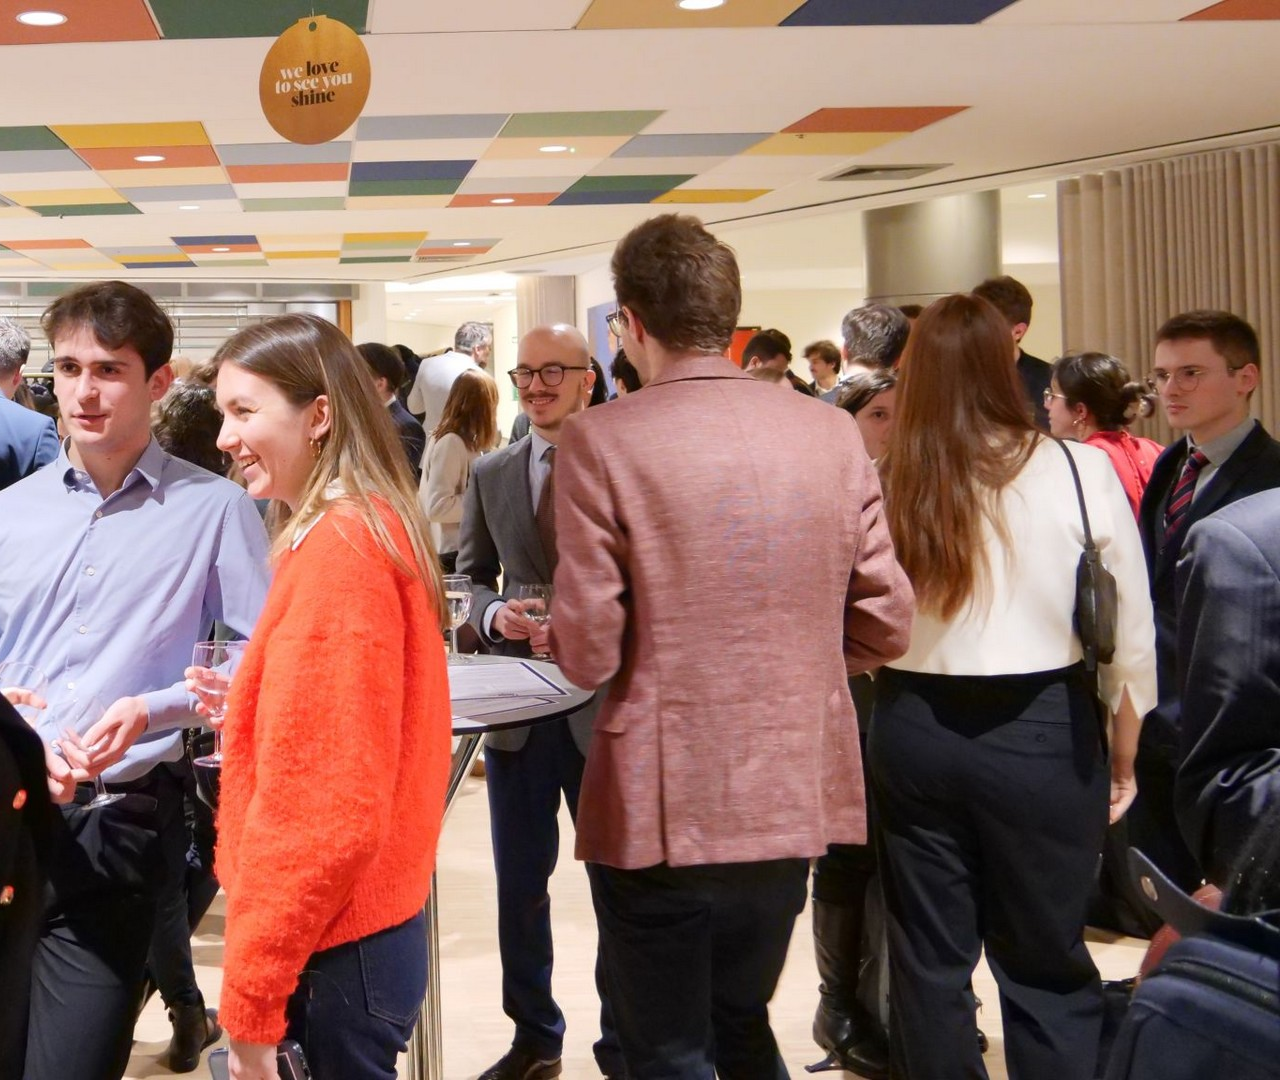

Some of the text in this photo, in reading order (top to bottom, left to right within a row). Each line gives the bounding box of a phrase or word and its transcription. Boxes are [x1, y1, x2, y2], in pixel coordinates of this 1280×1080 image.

[280, 61, 339, 80] we love
[275, 72, 353, 94] to see you
[291, 90, 336, 108] shine
